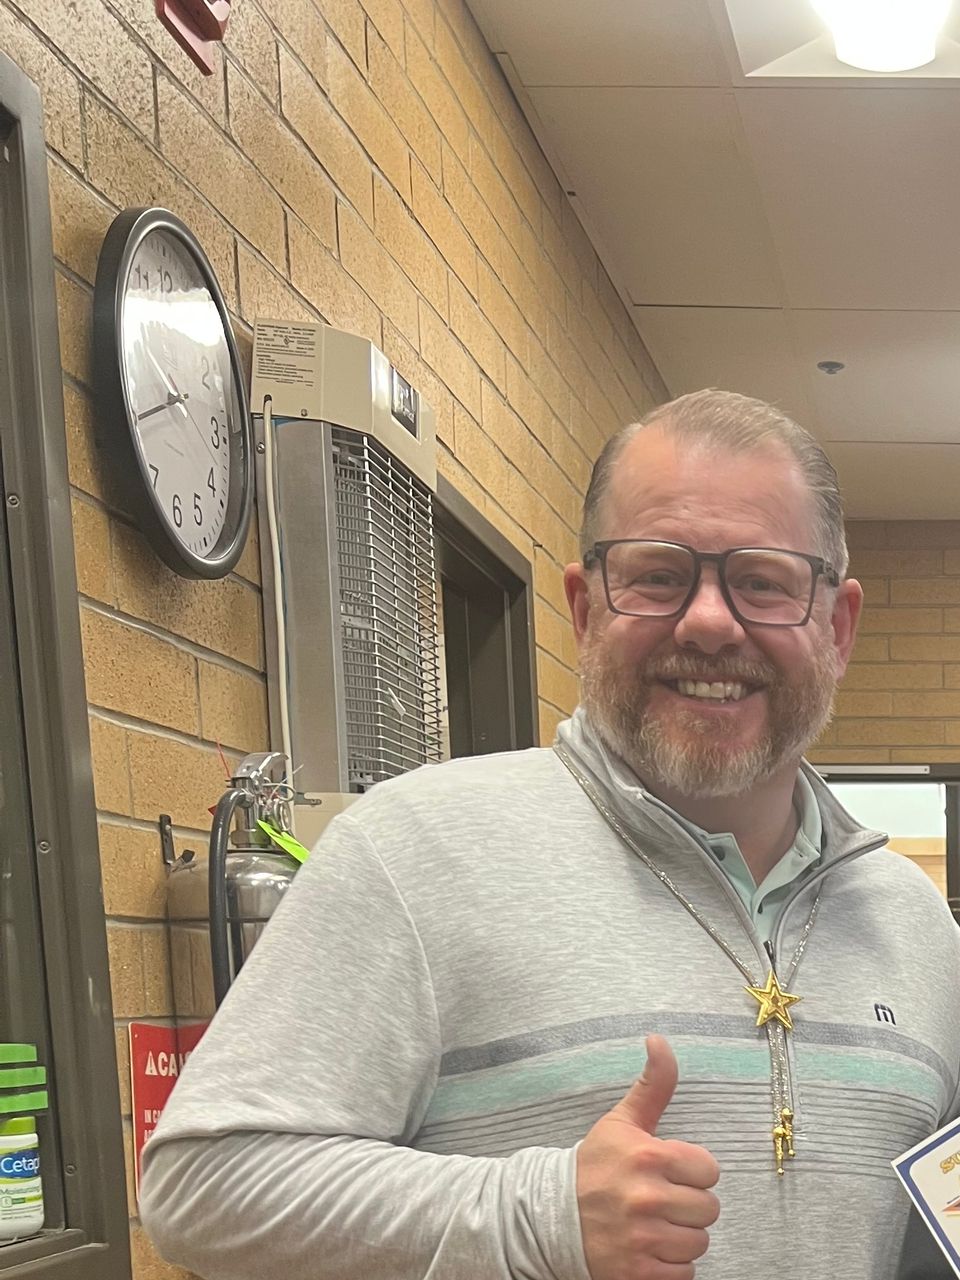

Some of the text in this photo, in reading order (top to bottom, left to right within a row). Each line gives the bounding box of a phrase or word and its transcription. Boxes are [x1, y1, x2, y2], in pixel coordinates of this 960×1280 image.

[210, 416, 220, 449] 3
[207, 467, 216, 496] 4
[171, 494, 183, 528] 6
[192, 492, 203, 526] 5
[0, 1157, 40, 1174] Cetap
